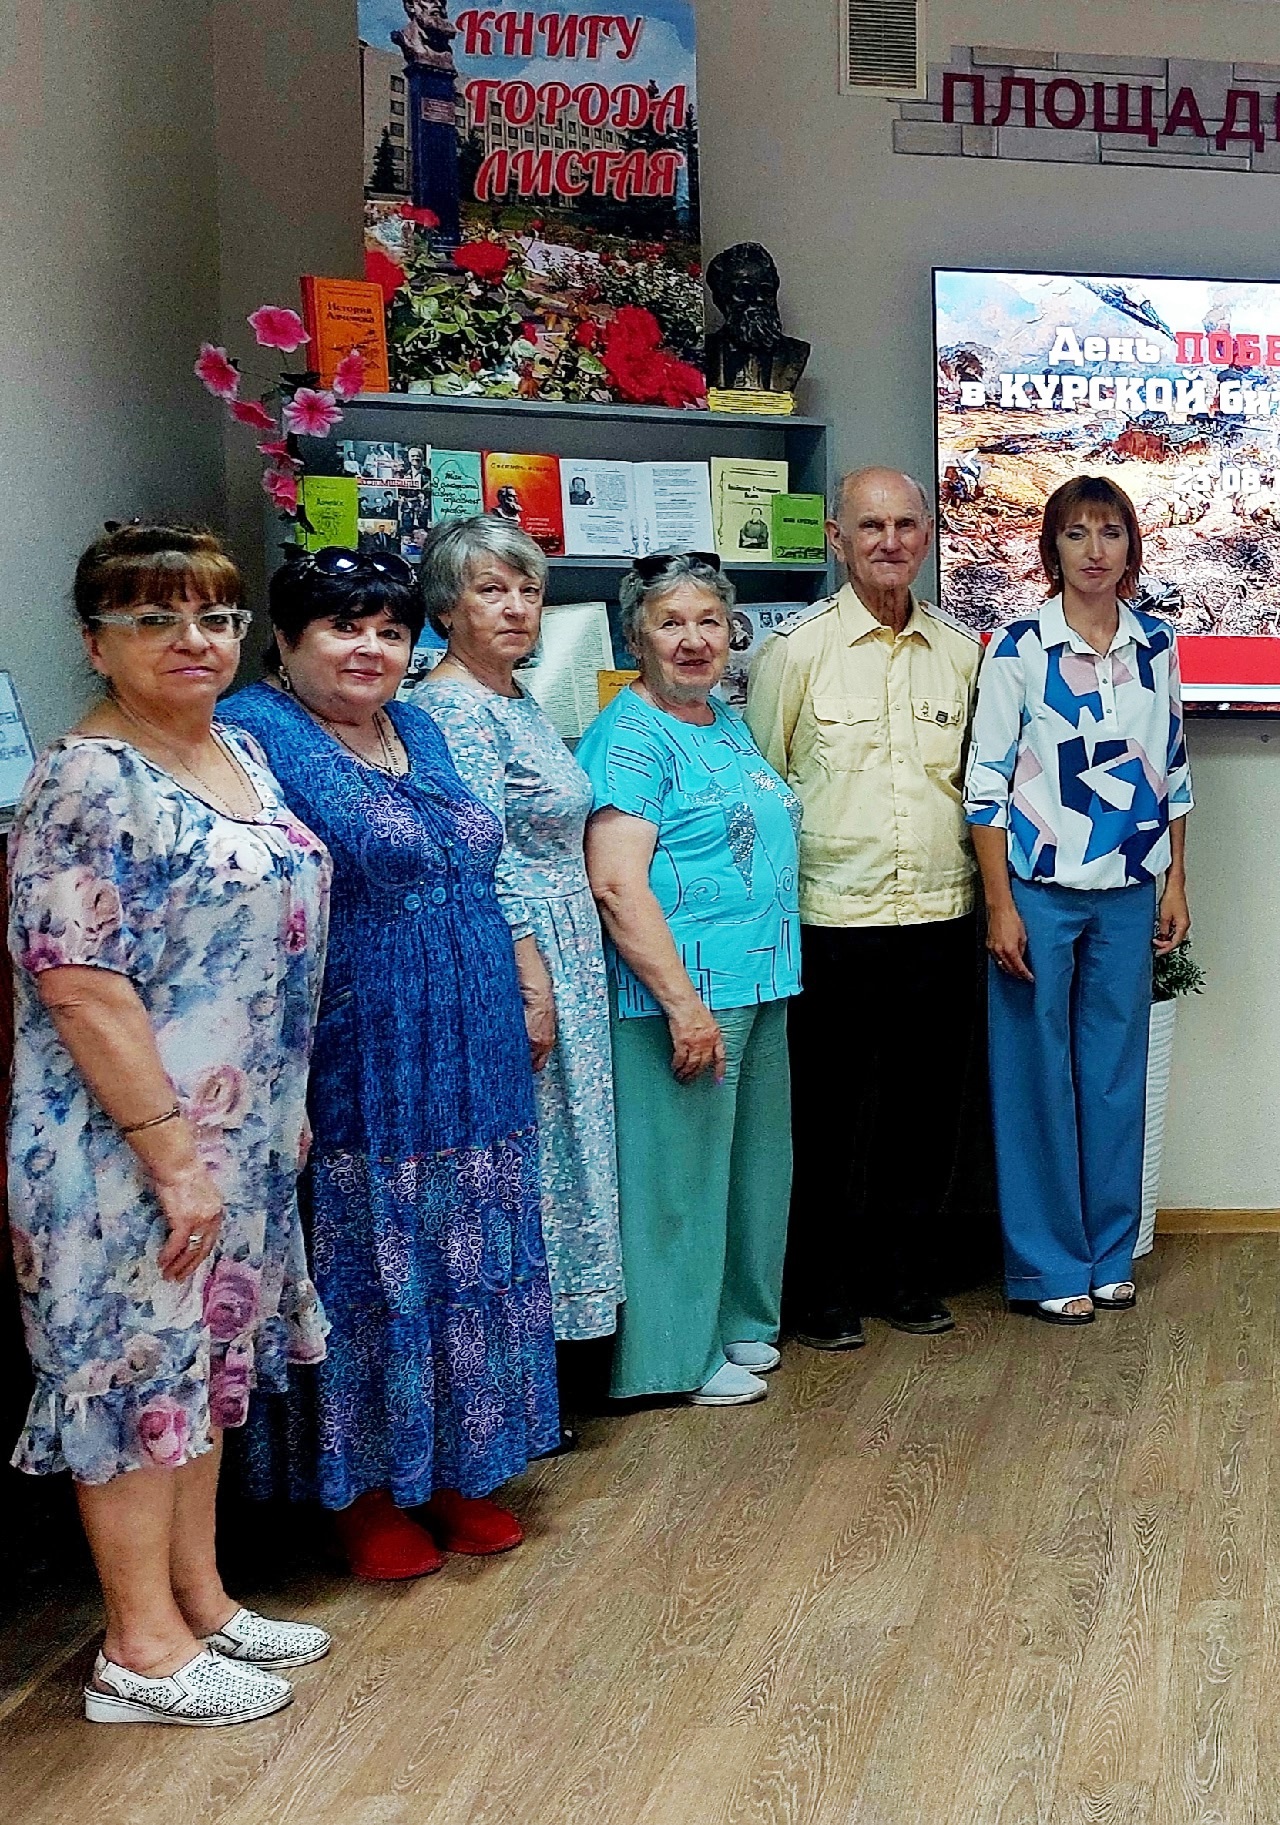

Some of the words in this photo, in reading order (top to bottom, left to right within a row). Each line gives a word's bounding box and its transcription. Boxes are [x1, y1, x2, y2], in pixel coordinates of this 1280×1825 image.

[455, 9, 642, 60] КНИГУ
[465, 79, 687, 134] ГОРОДА
[474, 149, 685, 201] ЛИСТАЯ
[1048, 326, 1162, 366] День
[960, 381, 985, 406] в
[1000, 369, 1203, 414] КУРСКОЙ
